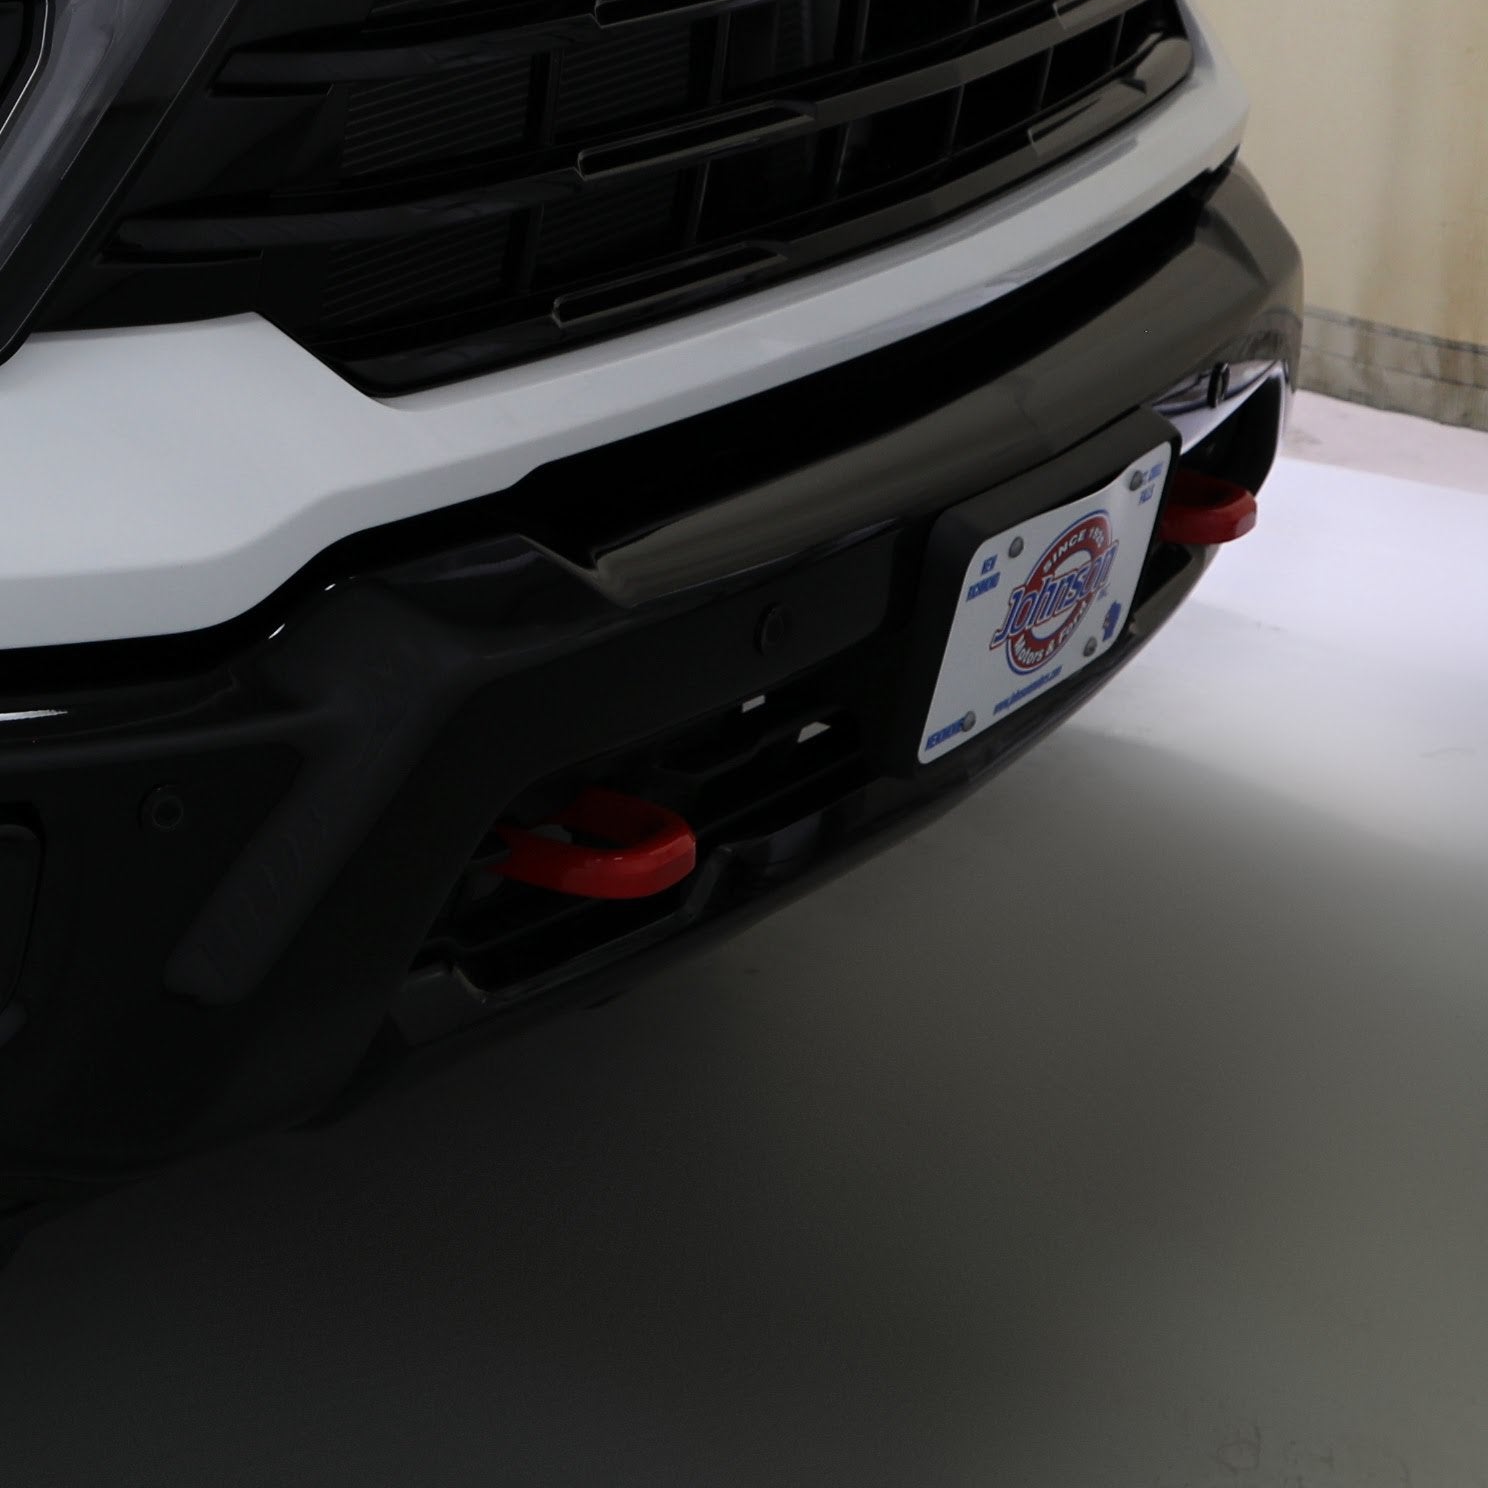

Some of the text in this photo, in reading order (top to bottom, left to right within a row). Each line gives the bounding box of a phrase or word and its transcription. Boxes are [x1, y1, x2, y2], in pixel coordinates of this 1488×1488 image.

[1043, 528, 1087, 574] SINCE
[989, 540, 1119, 650] Johnson
[1014, 633, 1044, 665] Motors
